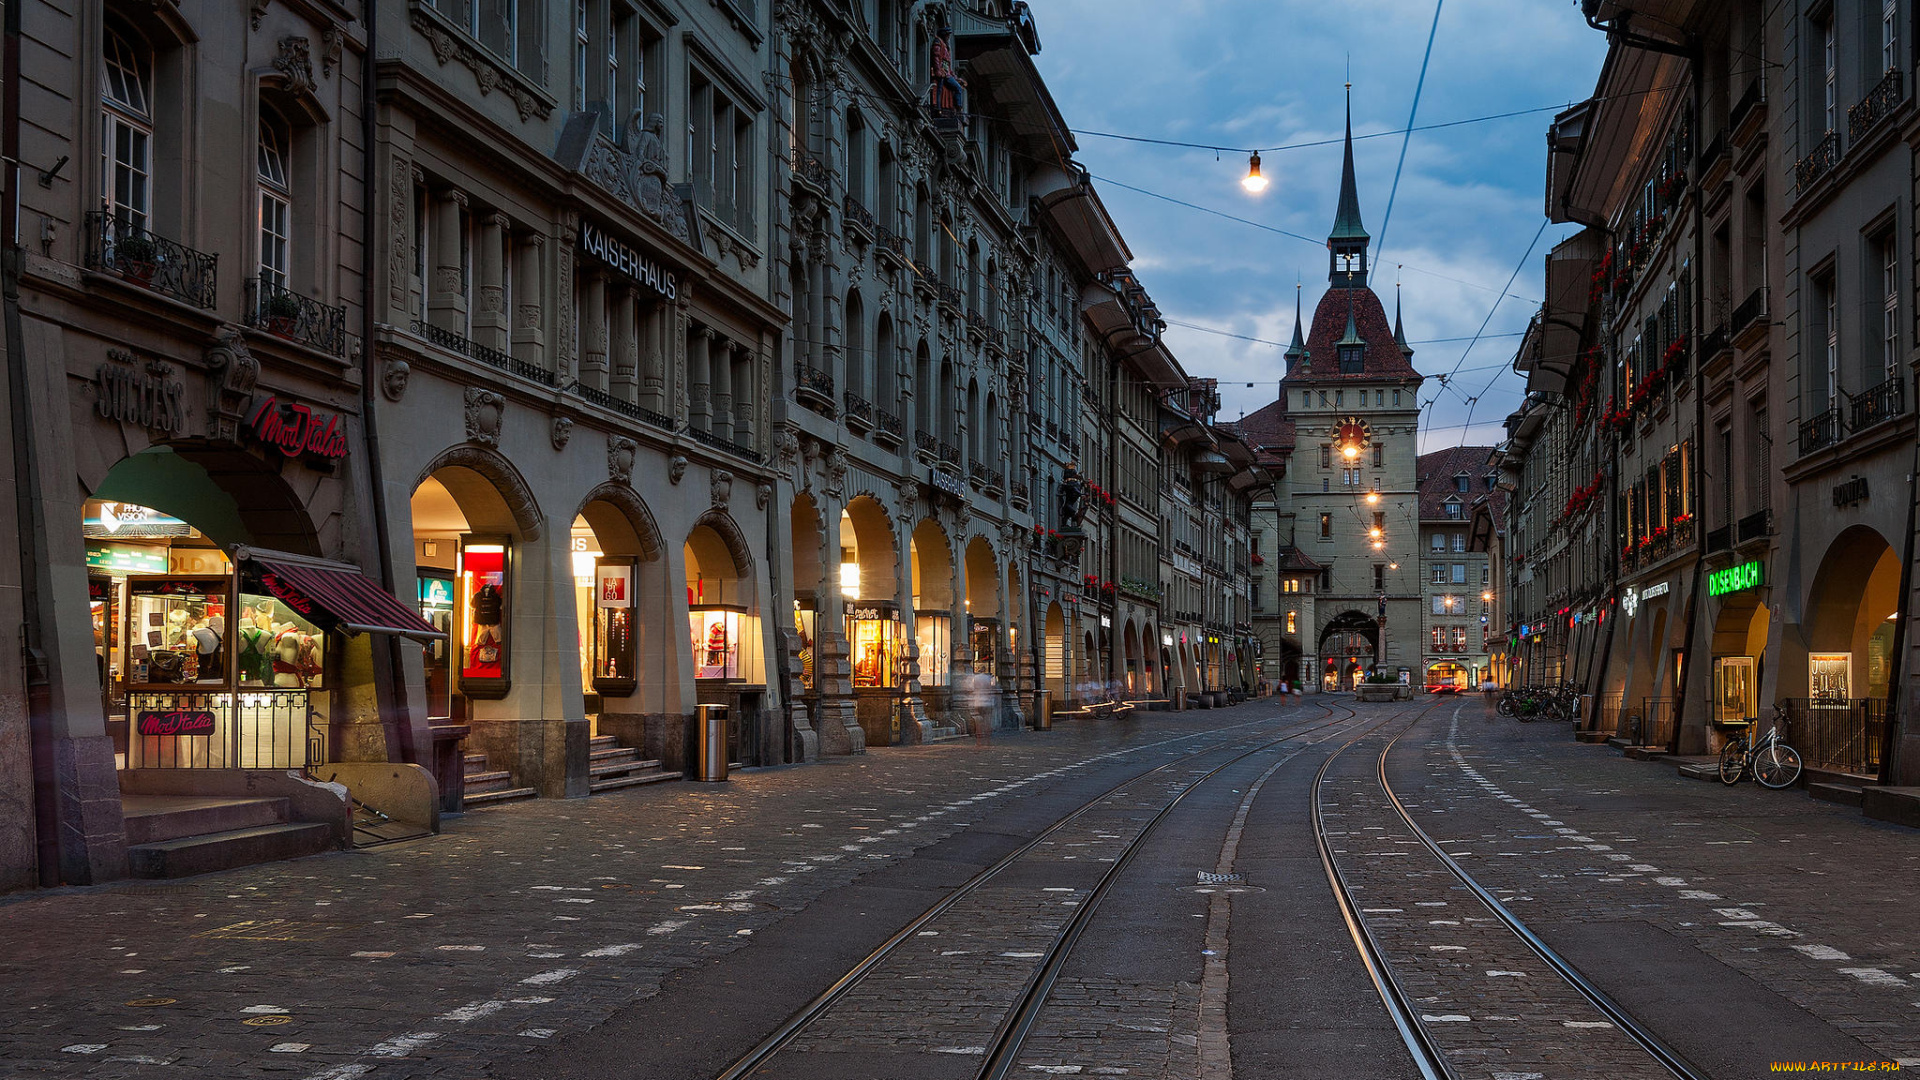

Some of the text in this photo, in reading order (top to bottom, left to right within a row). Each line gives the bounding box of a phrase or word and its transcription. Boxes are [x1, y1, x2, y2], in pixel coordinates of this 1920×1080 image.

[584, 221, 675, 300] KAISERHAUS
[97, 363, 184, 433] SUCCESS
[117, 512, 148, 521] VISION
[1709, 561, 1758, 597] DOSENBACH
